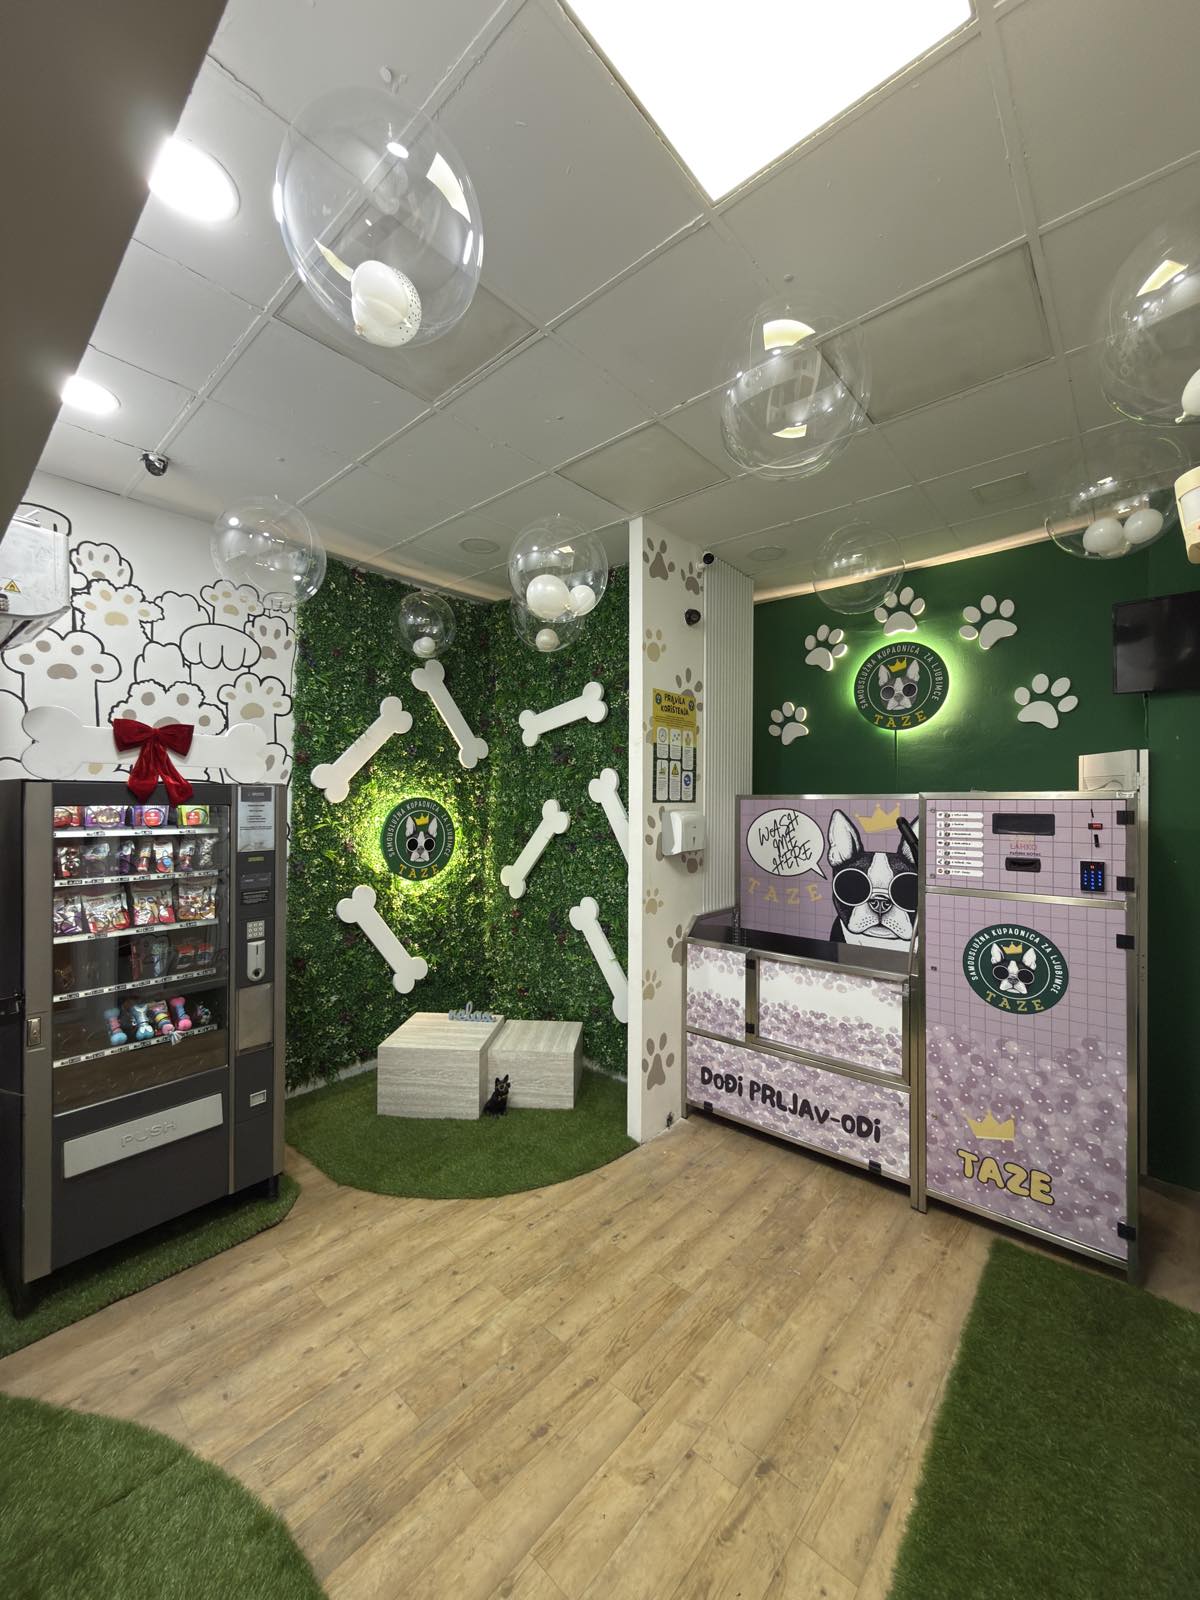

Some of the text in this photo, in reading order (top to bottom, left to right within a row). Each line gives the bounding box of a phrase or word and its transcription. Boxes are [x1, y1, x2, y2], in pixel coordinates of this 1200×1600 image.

[877, 644, 920, 660] KUPAONICA
[923, 652, 934, 663] ZA
[931, 662, 945, 702] LJUBIMCE
[874, 710, 927, 728] TAZE
[758, 811, 799, 846] WASH
[772, 832, 798, 854] ME
[398, 863, 439, 878] TAZE
[772, 840, 813, 875] HERE
[746, 877, 824, 906] TAZE
[991, 927, 1041, 943] KUPAONICA
[1041, 943, 1053, 954] ZA
[1050, 955, 1064, 994] LJUBIMCE
[985, 991, 1045, 1012] TAZE
[120, 1121, 177, 1148] PUSH
[956, 1148, 1055, 1205] TAZE
